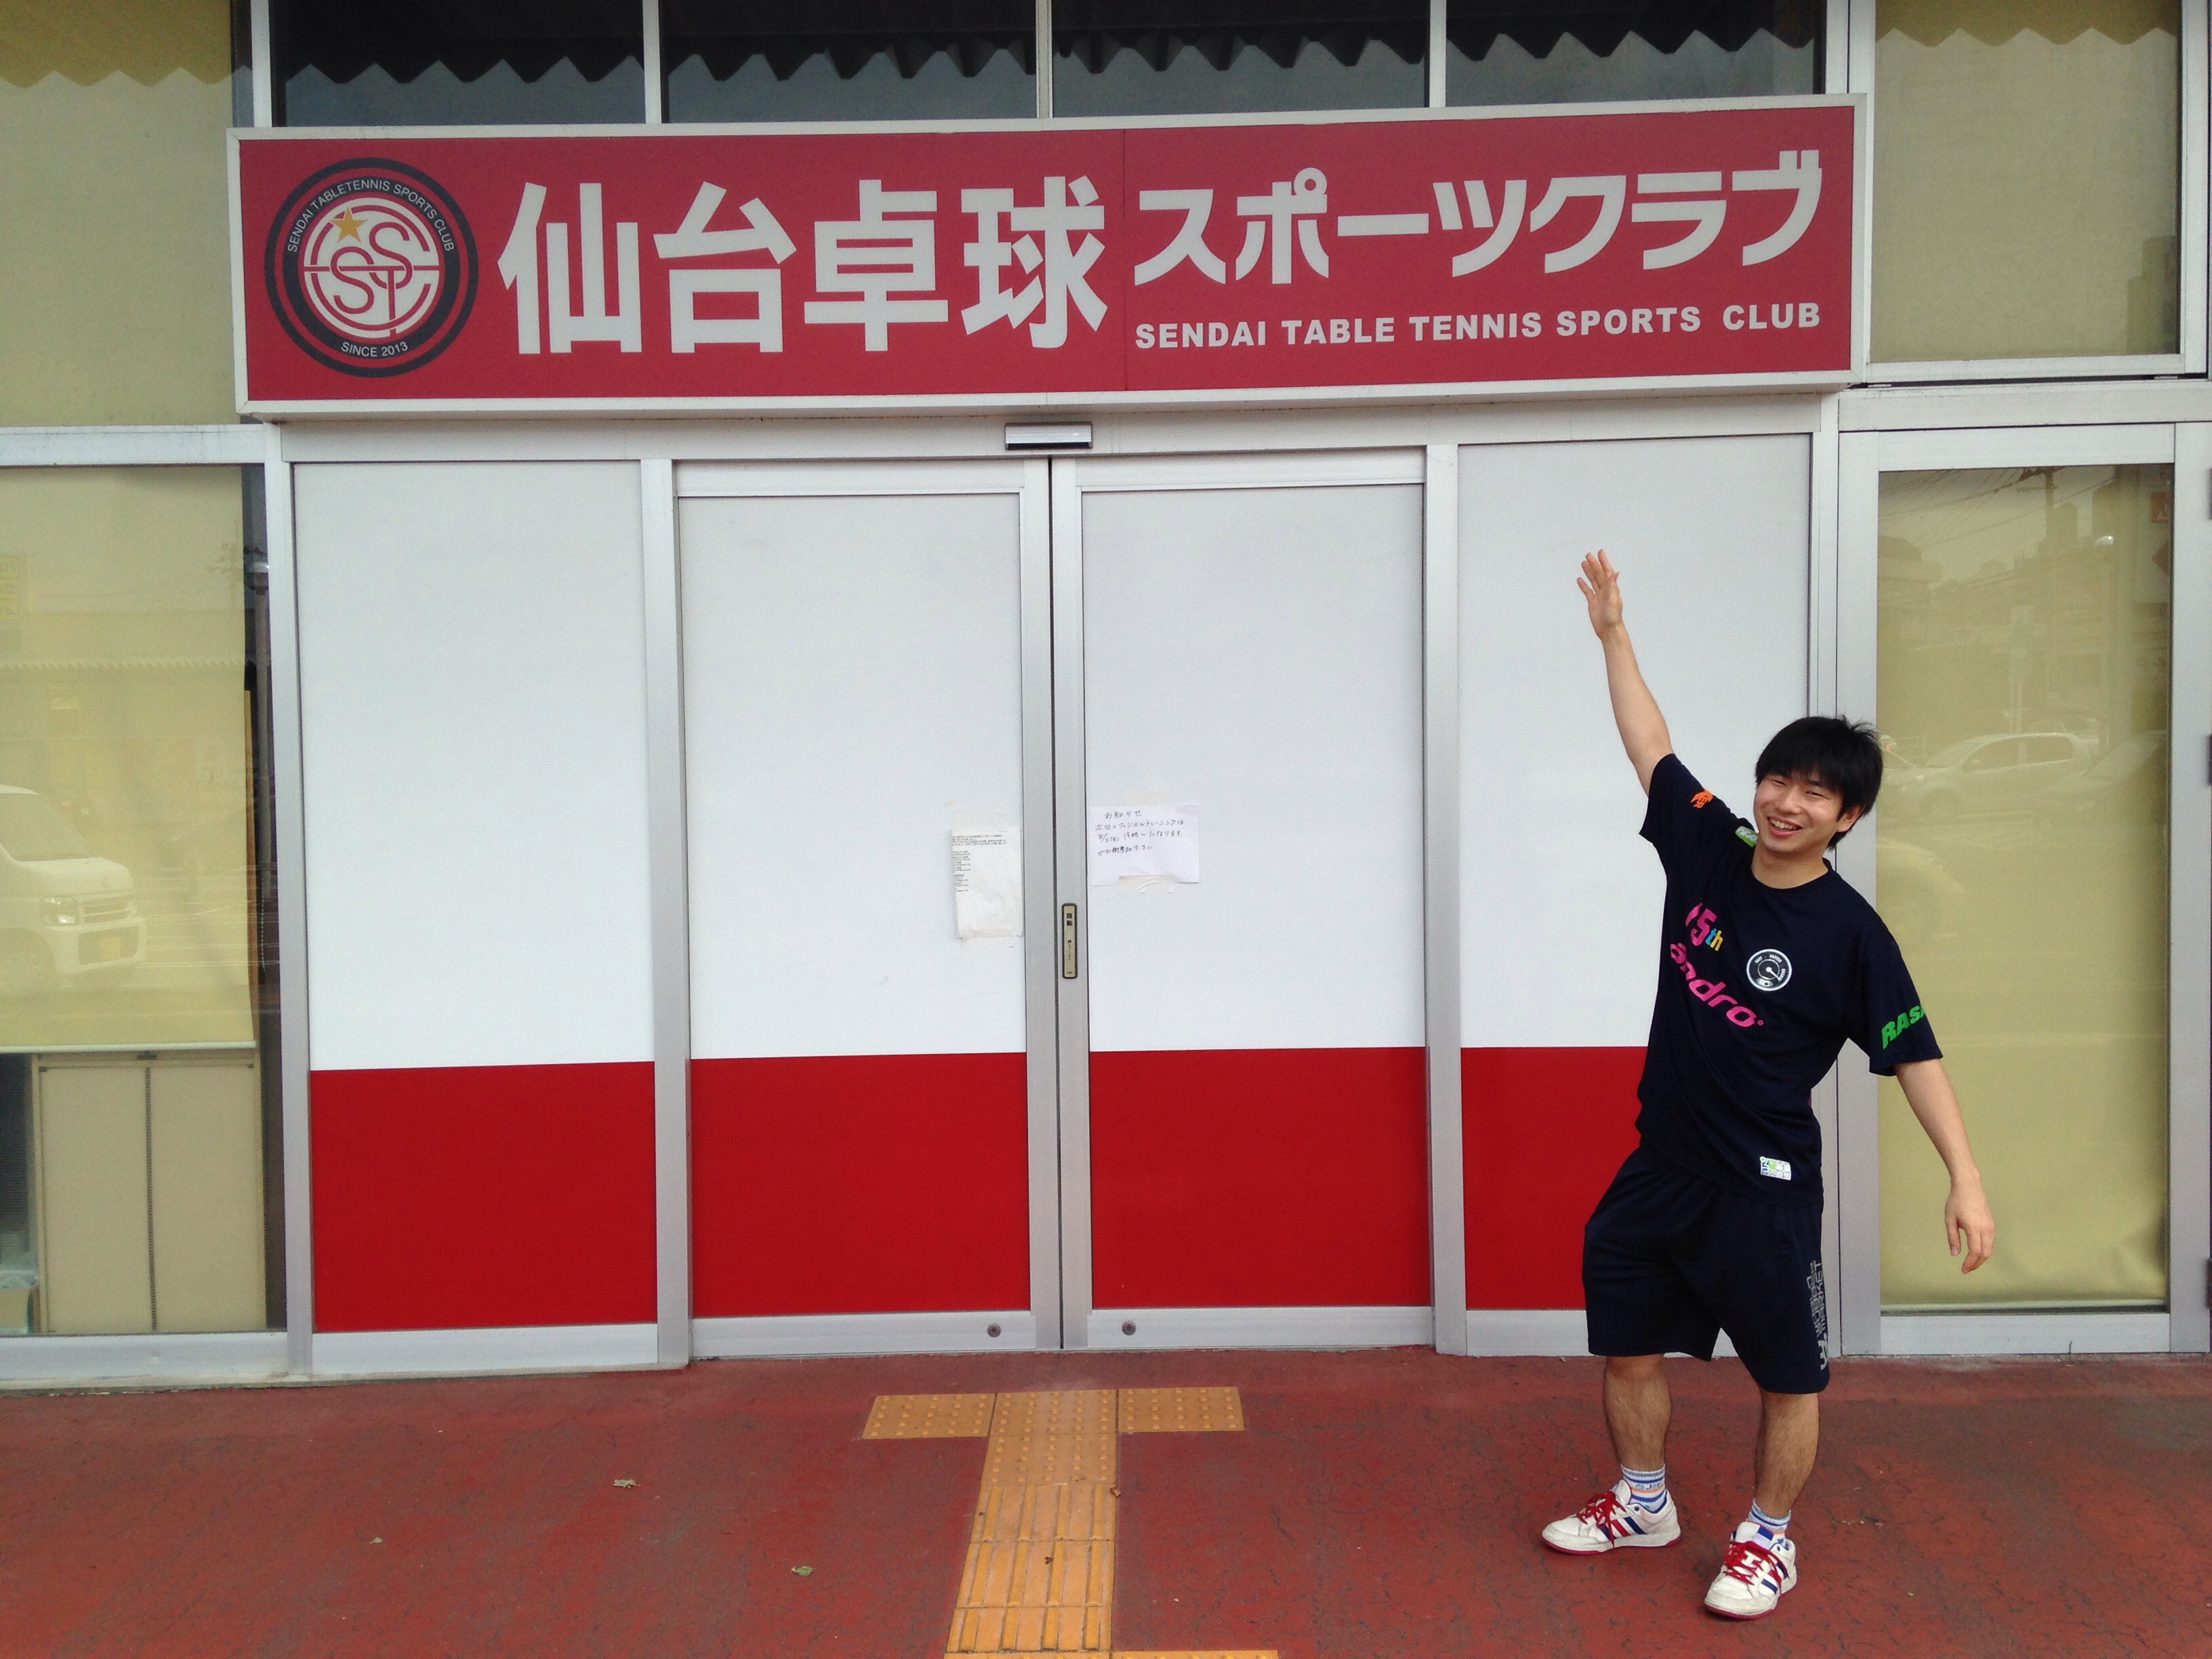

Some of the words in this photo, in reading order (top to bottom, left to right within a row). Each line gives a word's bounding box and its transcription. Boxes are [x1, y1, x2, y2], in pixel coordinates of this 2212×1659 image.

[287, 209, 314, 253] SENDAI
[310, 179, 391, 213] TABLETENNIS
[393, 184, 438, 220] SPORTS
[434, 218, 455, 251] CLUB
[497, 176, 1107, 354] 仙台卓球
[1134, 150, 1822, 285] スポーツクラブ
[1136, 321, 1265, 348] SENDAI
[1282, 318, 1394, 344] TABLE
[1409, 312, 1541, 340] TENNIS
[1557, 307, 1700, 335] SPORTS
[1723, 303, 1820, 330] CLUB
[341, 341, 377, 357] SINCE
[382, 341, 409, 357] 2013
[1104, 810, 1143, 819] お知らせ
